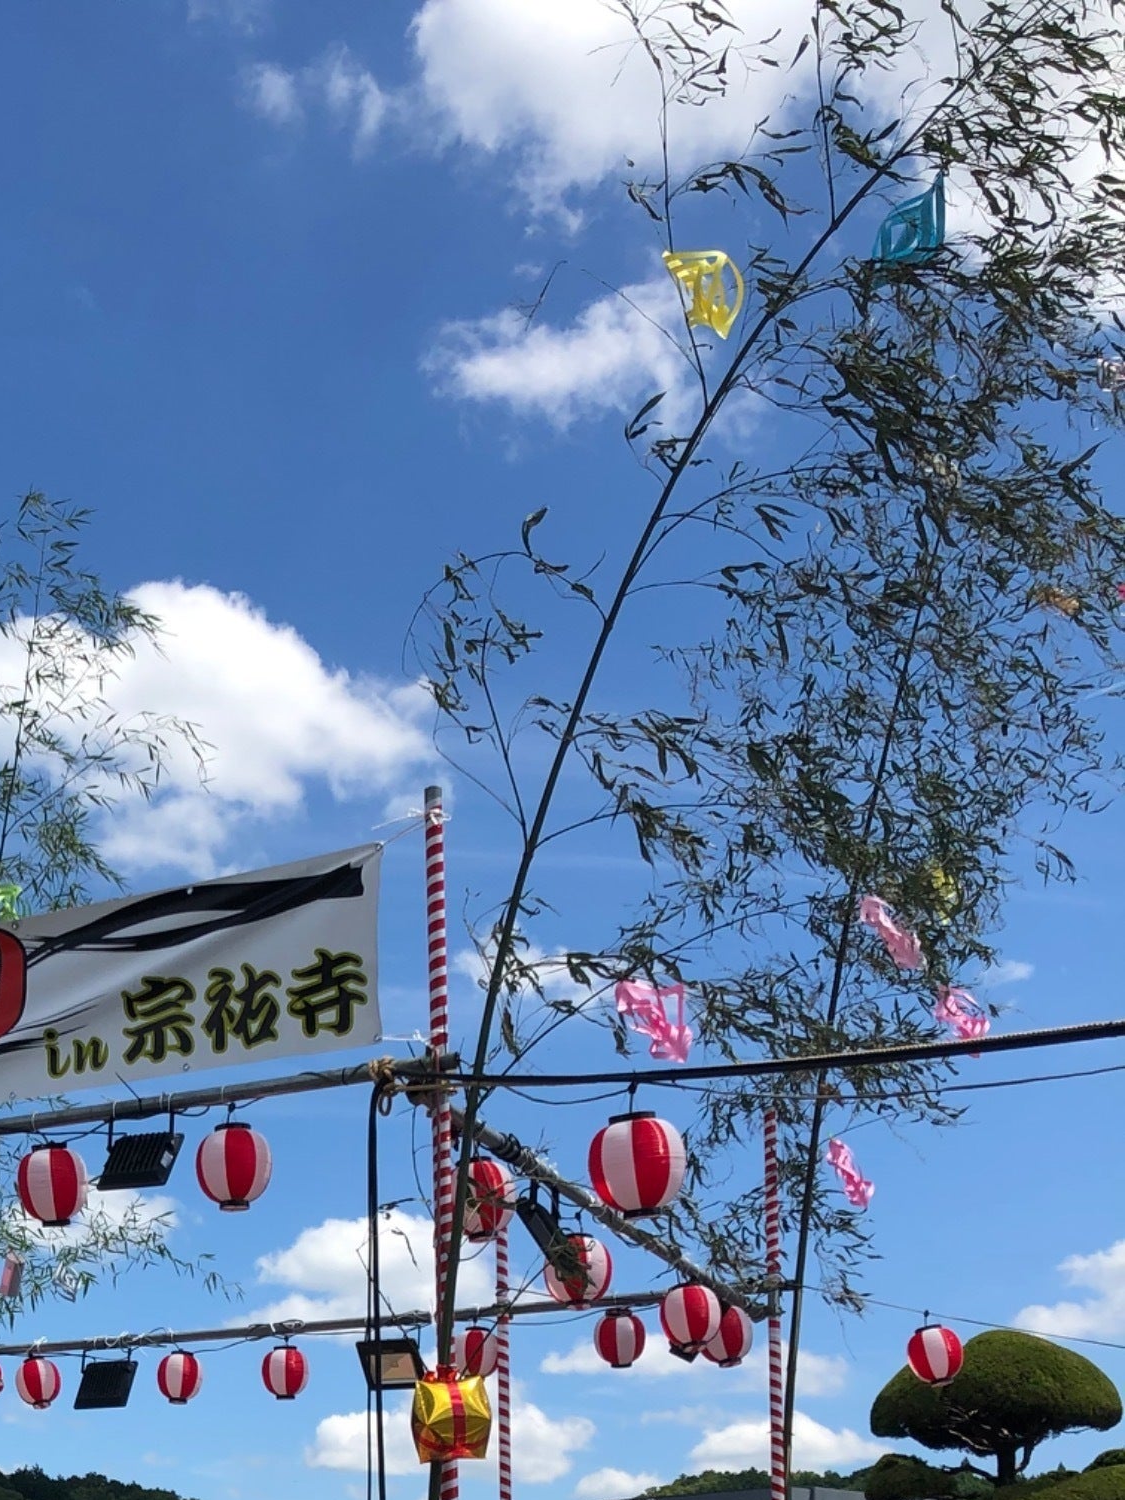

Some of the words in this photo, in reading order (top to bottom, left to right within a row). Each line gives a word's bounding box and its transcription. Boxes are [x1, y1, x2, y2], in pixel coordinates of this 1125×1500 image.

[42, 1027, 110, 1080] in
[121, 947, 369, 1065] 宗祐寺
